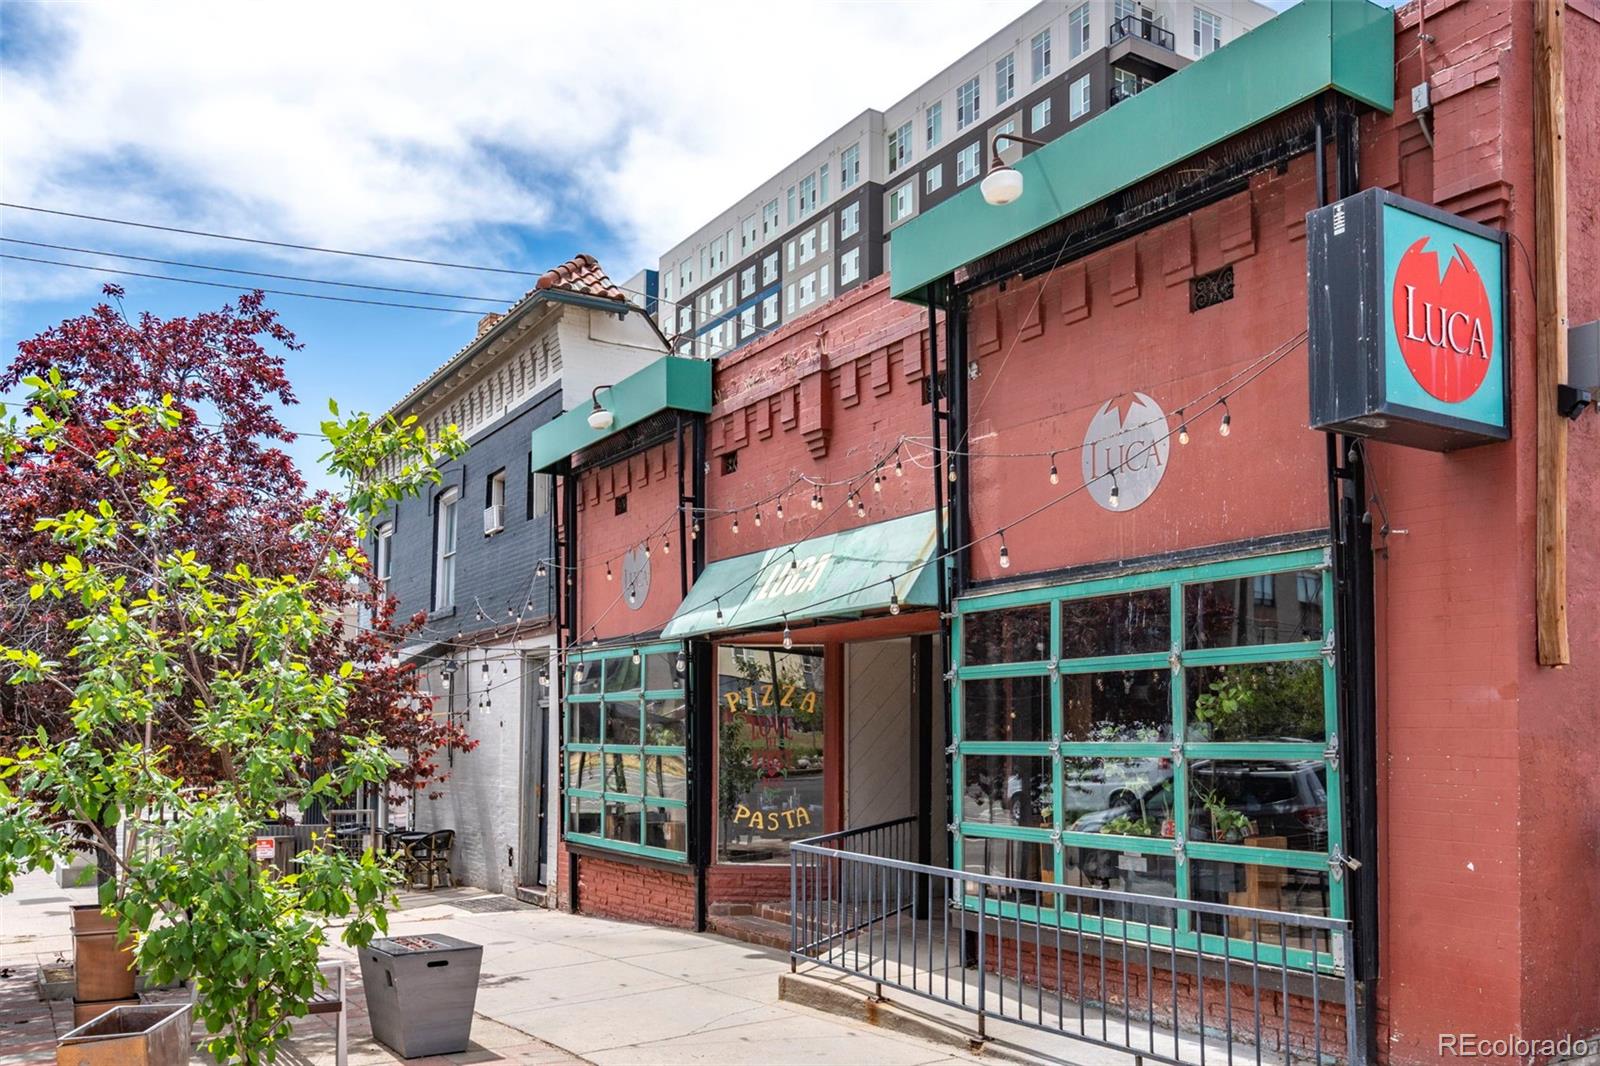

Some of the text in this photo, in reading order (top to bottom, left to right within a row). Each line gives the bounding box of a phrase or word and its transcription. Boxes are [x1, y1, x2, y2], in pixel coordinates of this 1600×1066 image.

[1405, 284, 1489, 359] LUCA
[724, 683, 817, 713] PIZZA
[733, 804, 811, 831] PASTA
